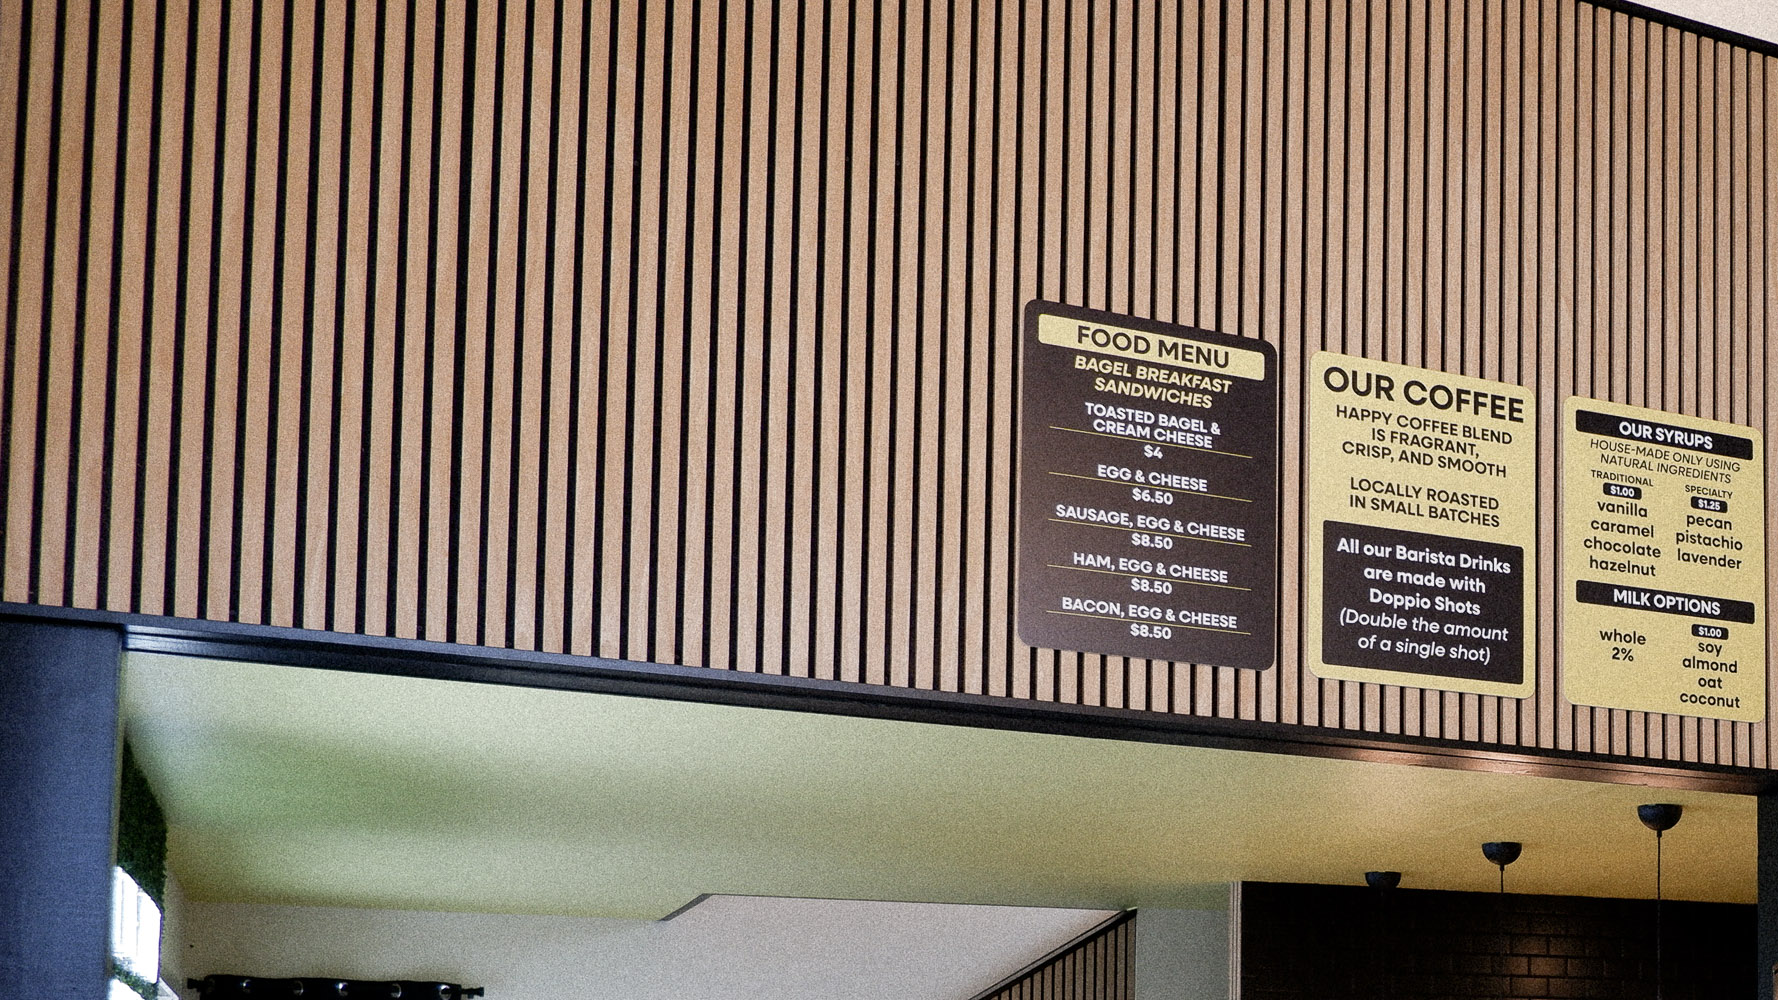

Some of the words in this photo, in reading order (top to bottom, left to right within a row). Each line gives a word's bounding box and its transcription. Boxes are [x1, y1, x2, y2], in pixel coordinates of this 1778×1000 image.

[1077, 325, 1151, 355] FOOD
[1158, 338, 1230, 369] MENU
[1074, 356, 1131, 378] BAGEL
[1135, 366, 1232, 394] BREAKFAST
[1094, 378, 1212, 408] SANDWICHES
[1323, 366, 1394, 402] OUR
[1403, 380, 1524, 423] COFFEE
[1085, 402, 1155, 424] TOASTED
[1158, 412, 1208, 432] BAGEL
[1211, 422, 1221, 435] &
[1336, 404, 1392, 425] HAPPY
[1397, 415, 1458, 436] COFFEE
[1462, 426, 1512, 444] BLEND
[1093, 419, 1150, 439] CREAM
[1154, 428, 1212, 448] CHEESE
[1372, 428, 1386, 442] IS
[1390, 431, 1480, 458] FRAGRANT,
[1619, 422, 1653, 439] OUR
[1656, 427, 1713, 449] SYRUPS
[1144, 444, 1163, 459] $4
[1342, 441, 1395, 462] CRISP,
[1399, 449, 1433, 467] AND
[1438, 456, 1507, 478] SMOOTH
[1591, 439, 1670, 462] HOUSE-MADE
[1673, 452, 1703, 467] ONLY
[1706, 458, 1741, 472] USING
[1098, 464, 1131, 481] EGG
[1135, 470, 1145, 482] &
[1148, 471, 1208, 491] CHEESE
[1591, 470, 1653, 487] TRADITIONAL
[1600, 454, 1654, 472] NATURAL
[1657, 463, 1731, 484] INGREDIENTS
[1132, 488, 1173, 505] $6.50
[1350, 477, 1422, 499] LOCALLY
[1427, 488, 1499, 510] ROASTED
[1610, 486, 1635, 497] $1.00
[1685, 485, 1733, 499] SPECIALTY
[1350, 495, 1366, 509] IN
[1371, 498, 1424, 518] SMALL
[1429, 507, 1500, 527] BATCHES
[1597, 501, 1647, 518] vanilla
[1698, 499, 1720, 511] $1.25
[1056, 504, 1131, 528] SAUSAGE,
[1138, 515, 1171, 532] EGG
[1174, 520, 1184, 533] &
[1187, 522, 1245, 541] CHEESE
[1591, 520, 1654, 538] caramel
[1687, 514, 1732, 531] pecan
[1131, 533, 1172, 550] $8.50
[1583, 537, 1661, 558] chocolate
[1676, 531, 1743, 552] pistachio
[1073, 552, 1115, 571] HAM,
[1119, 558, 1153, 574] EGG
[1156, 562, 1166, 575] &
[1170, 564, 1228, 583] CHEESE
[1337, 537, 1359, 555] All
[1363, 543, 1392, 558] our
[1396, 544, 1456, 567] Barista
[1459, 554, 1511, 574] Drinks
[1589, 556, 1656, 577] hazelnut
[1677, 549, 1742, 569] lavender
[1131, 578, 1172, 595] $8.50
[1364, 567, 1393, 582] are
[1397, 569, 1446, 588] made
[1449, 576, 1485, 593] with
[1062, 597, 1124, 618] BACON,
[1129, 603, 1162, 620] EGG
[1166, 608, 1176, 621] &
[1179, 609, 1237, 628] CHEESE
[1370, 589, 1431, 612] Doppio
[1435, 597, 1481, 616] Shots
[1614, 589, 1650, 606] MILK
[1653, 594, 1721, 615] OPTIONS
[1130, 623, 1172, 640] $8.50
[1340, 607, 1407, 630] (Double
[1412, 618, 1440, 633] the
[1443, 623, 1509, 641] amount
[1600, 629, 1646, 645] whole
[1698, 627, 1721, 638] $1.00
[1358, 634, 1376, 651] of
[1380, 640, 1392, 652] a
[1395, 639, 1446, 659] single
[1449, 645, 1491, 665] shot)
[1612, 647, 1634, 662] 2%
[1698, 642, 1722, 656] soy
[1682, 657, 1737, 674] almond
[1698, 677, 1722, 690] oat
[1680, 692, 1740, 708] coconut
